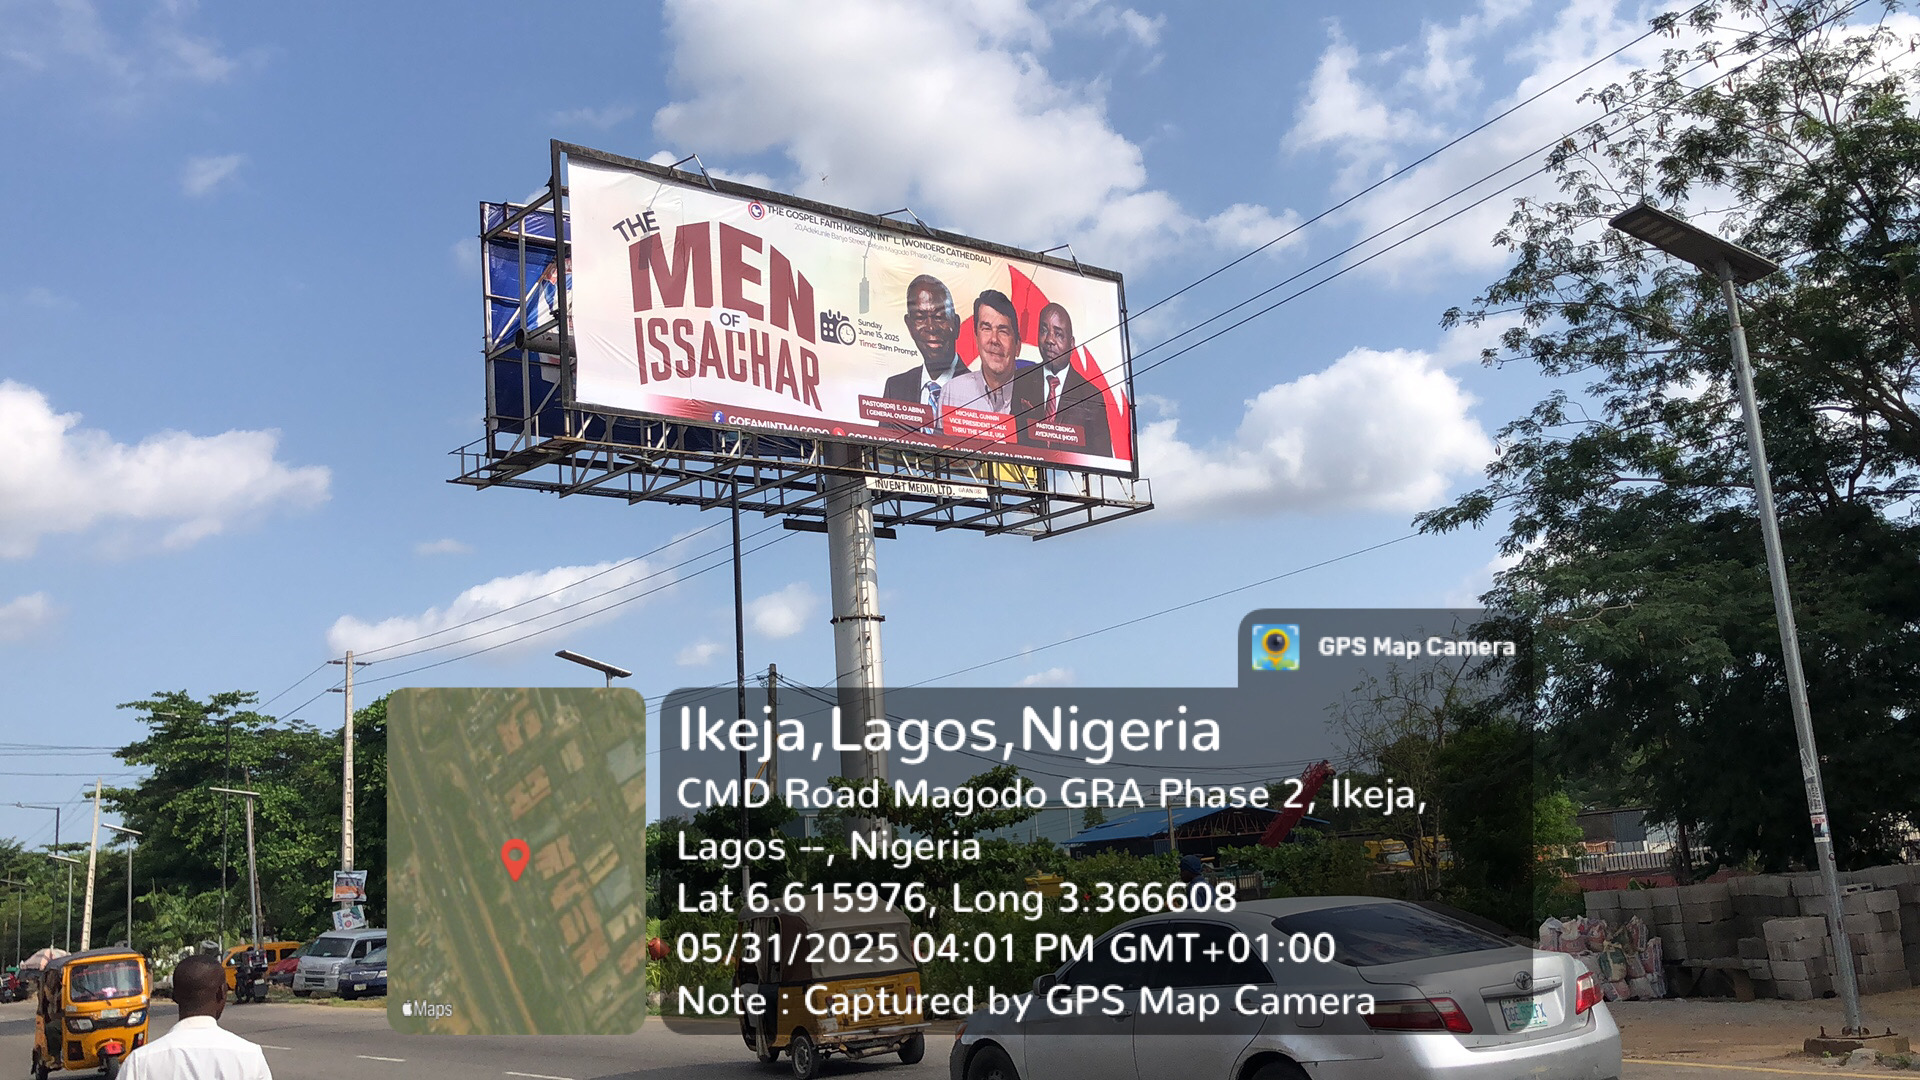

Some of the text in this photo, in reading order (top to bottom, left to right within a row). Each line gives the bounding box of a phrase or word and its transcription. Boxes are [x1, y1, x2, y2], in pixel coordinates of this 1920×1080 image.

[612, 210, 660, 242] THE
[767, 205, 785, 216] THE
[786, 210, 819, 225] GOSPEL
[820, 218, 843, 231] FAITH
[844, 223, 876, 239] MISSION
[902, 237, 945, 254] (WONDERS
[946, 247, 992, 266] CATHEDRAL)
[628, 221, 816, 345] MEN
[719, 313, 741, 327] OF
[858, 319, 883, 331] Sunday
[858, 328, 875, 337] June
[884, 333, 900, 342] 2025
[877, 343, 893, 352] 9am
[893, 346, 918, 357] Prompt
[634, 317, 823, 412] ISSACHAR
[874, 479, 907, 491] INVENT
[908, 481, 936, 494] MEDIA
[937, 484, 956, 496] LTD.
